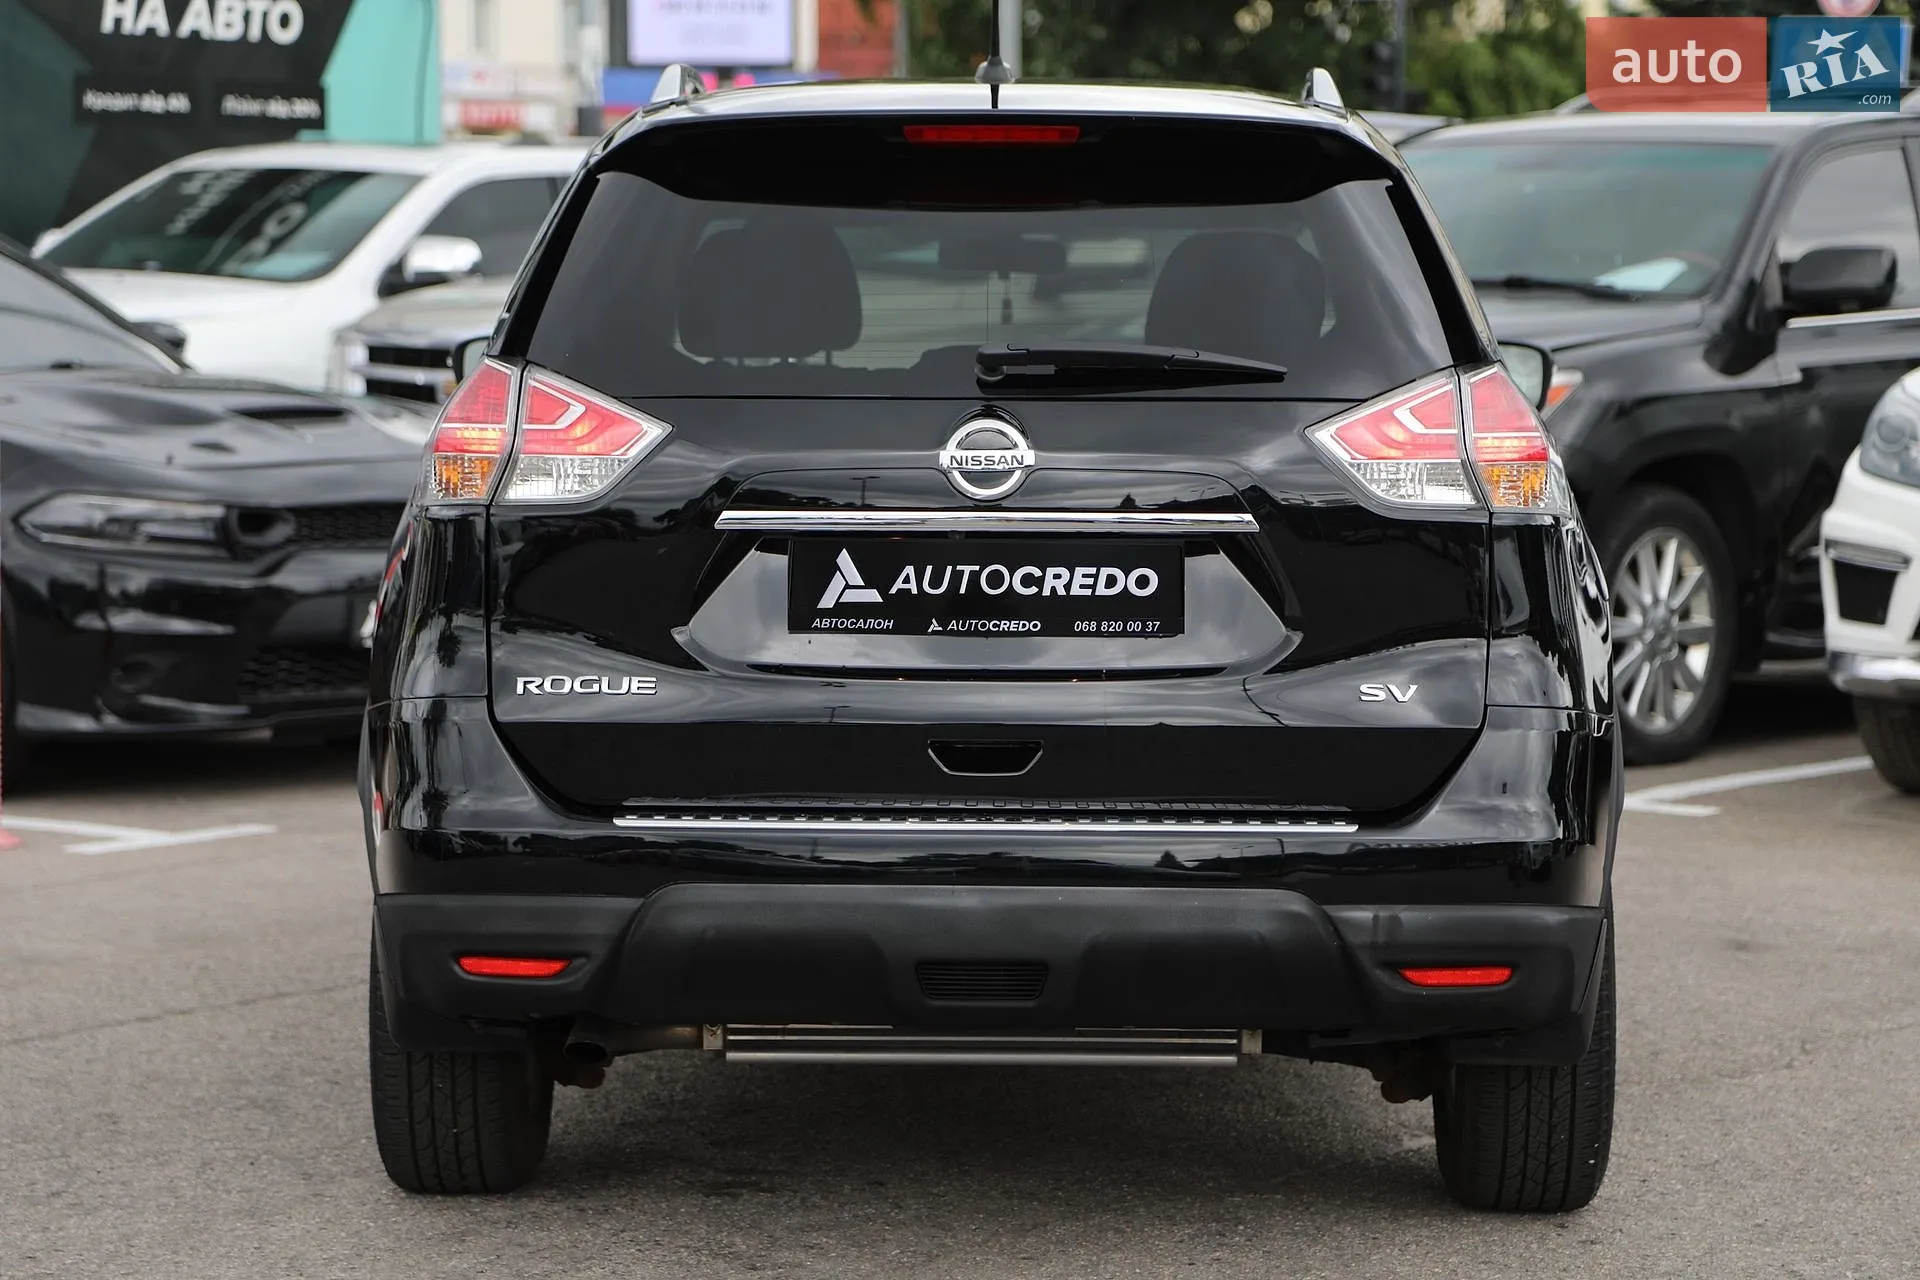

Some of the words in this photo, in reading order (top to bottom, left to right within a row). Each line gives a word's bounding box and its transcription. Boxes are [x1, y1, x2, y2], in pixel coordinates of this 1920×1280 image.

[101, 0, 170, 38] НА
[175, 0, 304, 45] АВТО
[949, 454, 1024, 467] NISSAN
[888, 564, 1159, 597] AUTOCREDO
[811, 618, 894, 630] АВТОСАЛОН
[946, 619, 1042, 632] AUTOCREDO
[1074, 620, 1097, 632] 068
[1100, 620, 1123, 632] 820
[1126, 620, 1142, 632] 00
[1145, 620, 1160, 632] 37
[516, 675, 657, 696] ROGUE
[1359, 683, 1418, 703] SV
